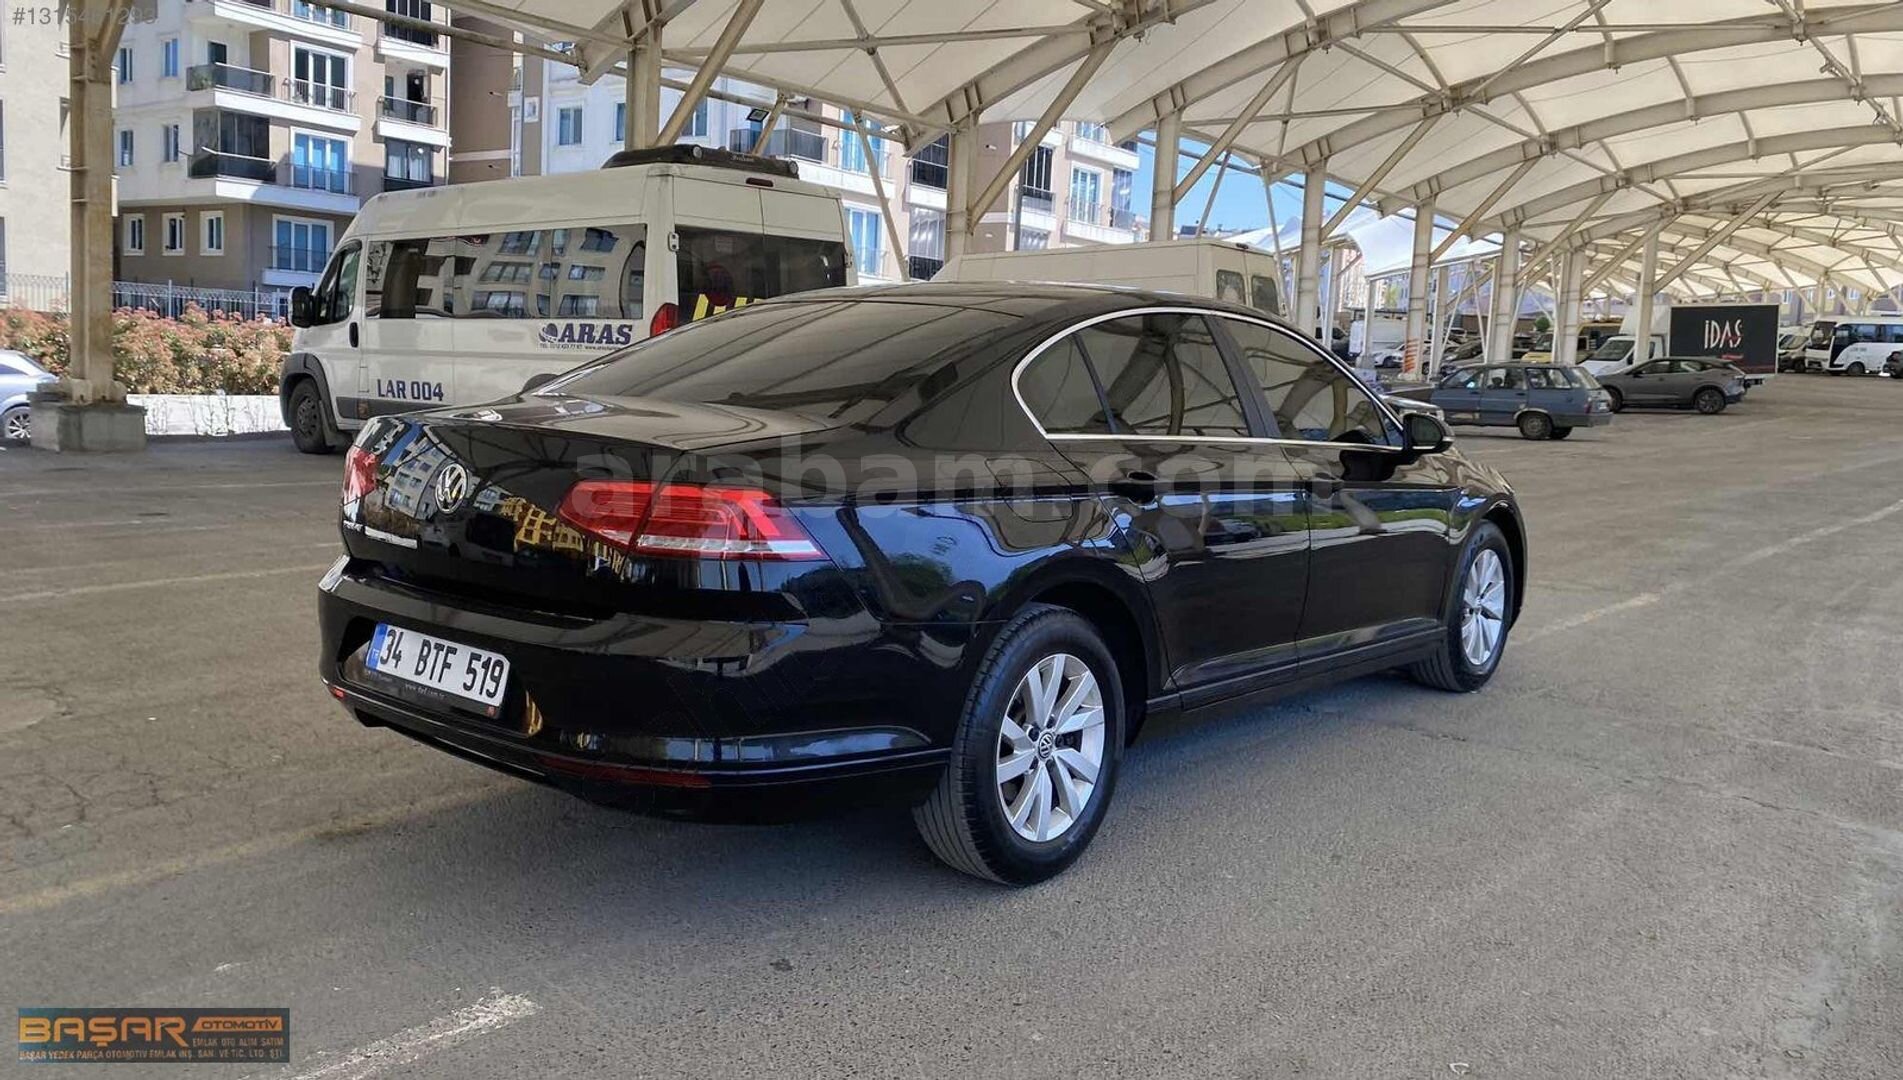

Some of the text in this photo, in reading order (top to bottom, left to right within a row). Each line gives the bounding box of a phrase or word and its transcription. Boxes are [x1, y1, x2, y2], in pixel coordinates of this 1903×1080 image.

[558, 322, 633, 345] ARAS
[377, 379, 444, 401] LAR 004
[380, 629, 404, 669] 34
[414, 639, 458, 683] BTF
[462, 652, 505, 699] 519
